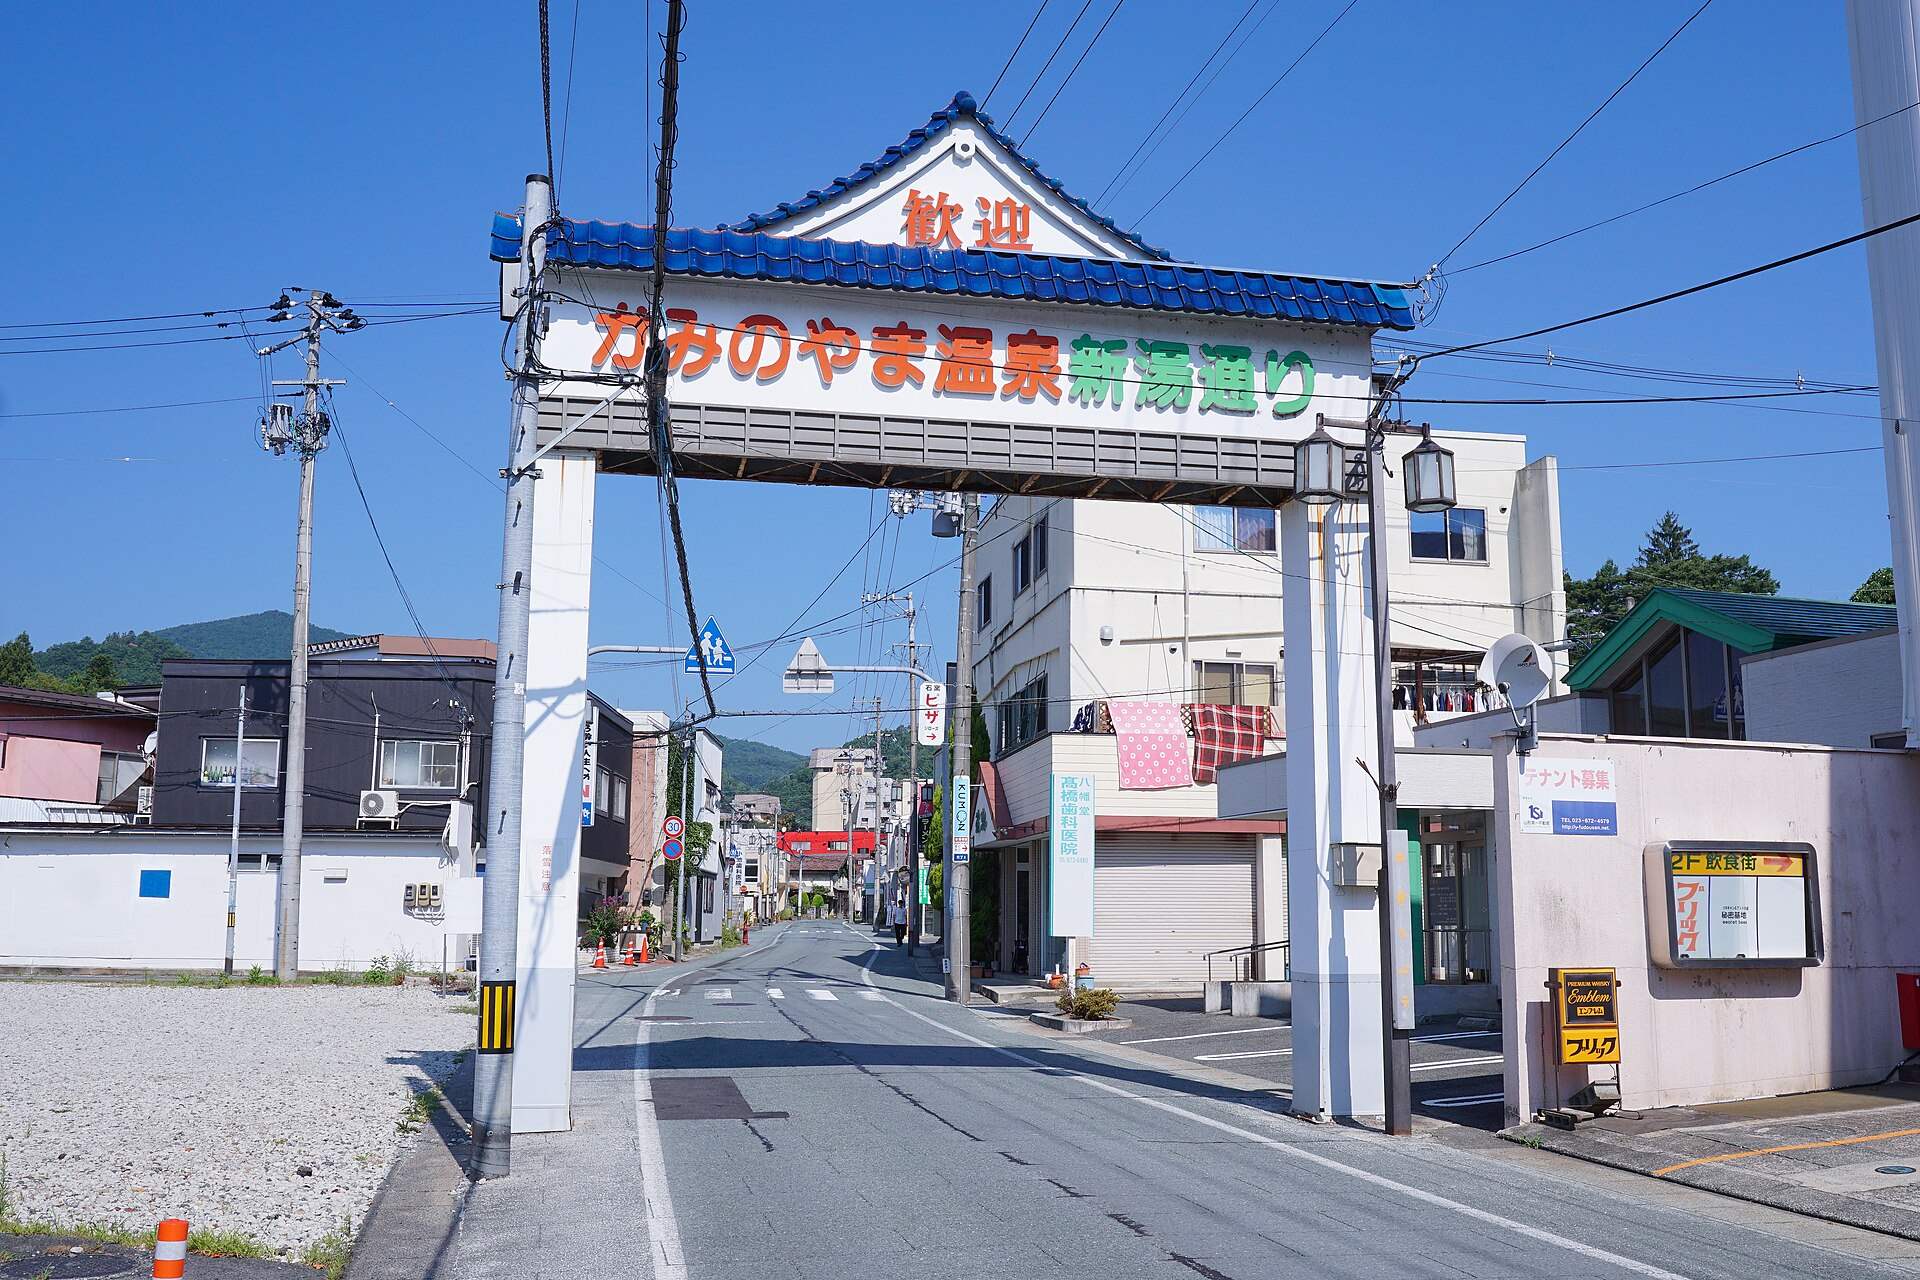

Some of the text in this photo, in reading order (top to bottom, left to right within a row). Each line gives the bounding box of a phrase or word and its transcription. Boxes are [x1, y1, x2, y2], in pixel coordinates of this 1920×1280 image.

[902, 189, 1033, 251] 歓迎
[925, 693, 940, 724] ピザ
[1526, 768, 1609, 790] テナント募集
[956, 784, 968, 832] KUMON
[1079, 777, 1090, 816] 八幡堂
[667, 822, 680, 832] 30
[1672, 851, 1757, 871] 2F 飲食街
[1677, 881, 1705, 952] ブリック
[1567, 988, 1612, 1004] Emblem
[1566, 1036, 1617, 1059] ブリック
